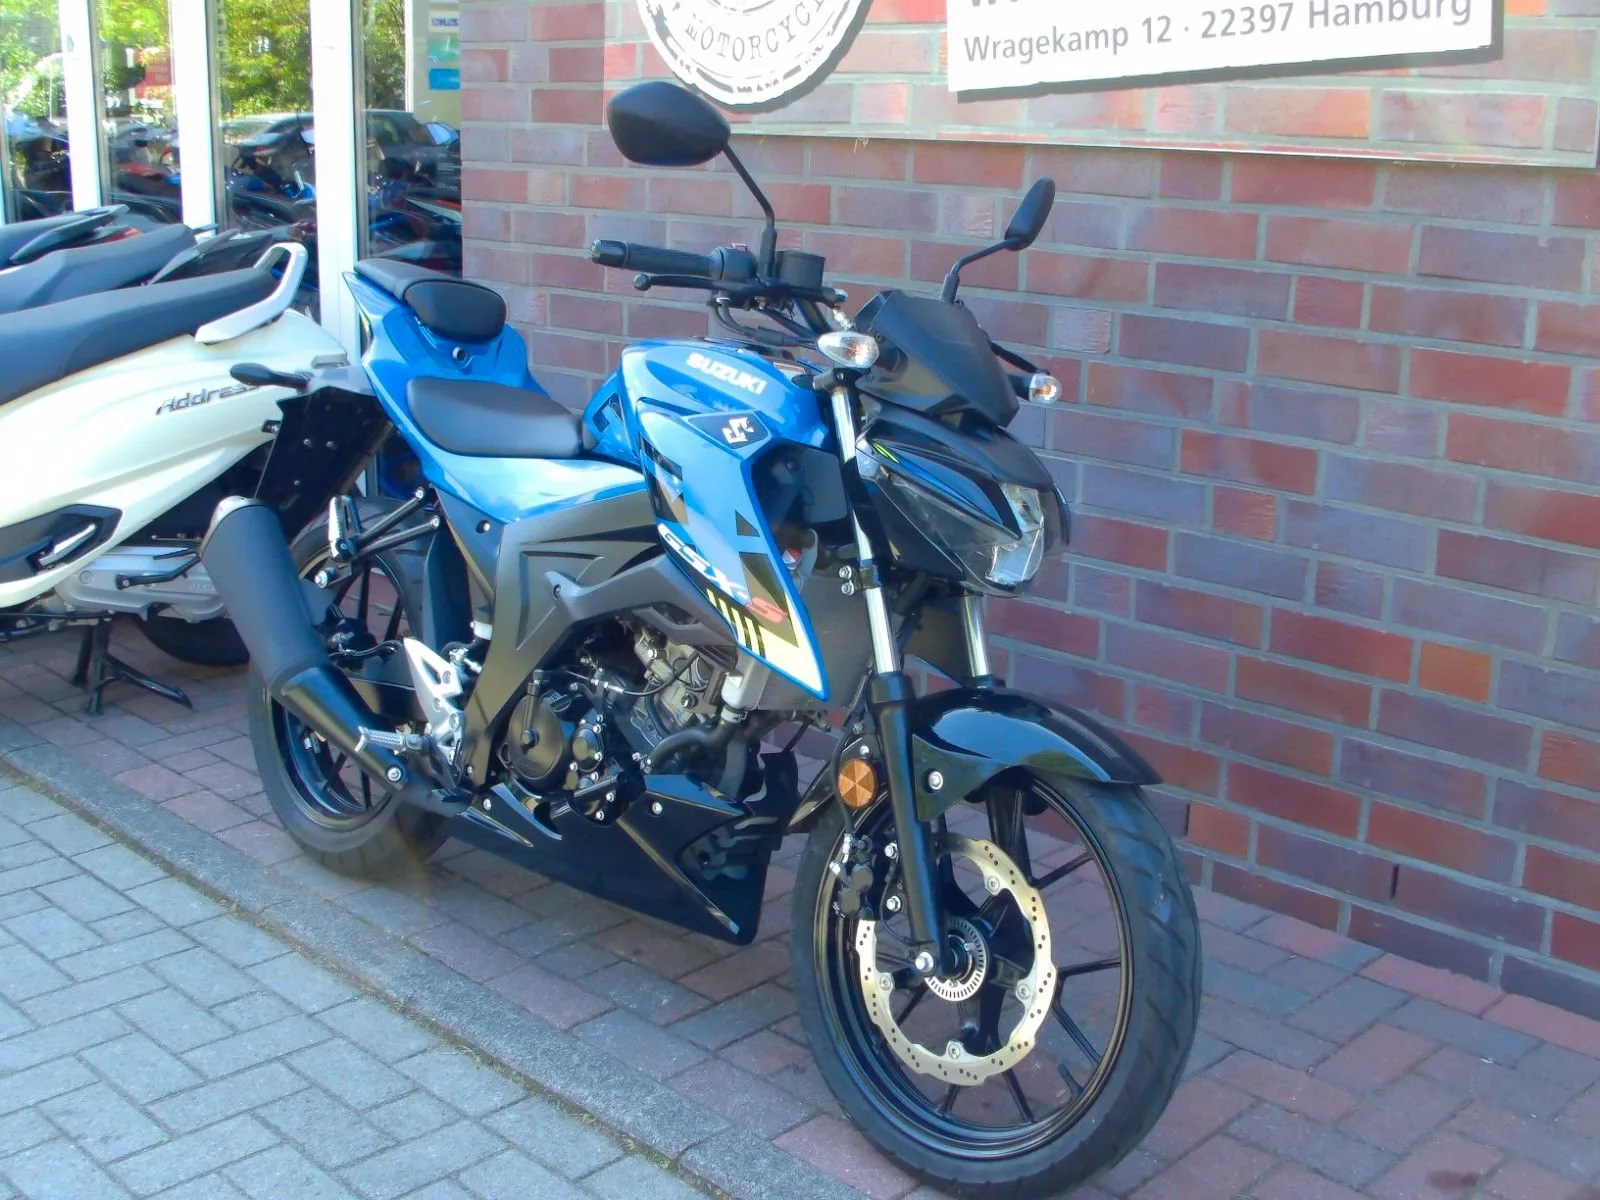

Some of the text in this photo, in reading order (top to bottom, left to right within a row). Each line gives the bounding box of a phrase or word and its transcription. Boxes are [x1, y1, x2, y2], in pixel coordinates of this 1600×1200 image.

[964, 0, 1471, 64] Wragekamp 12 22397 Hamburg
[686, 352, 767, 395] SUZUKI
